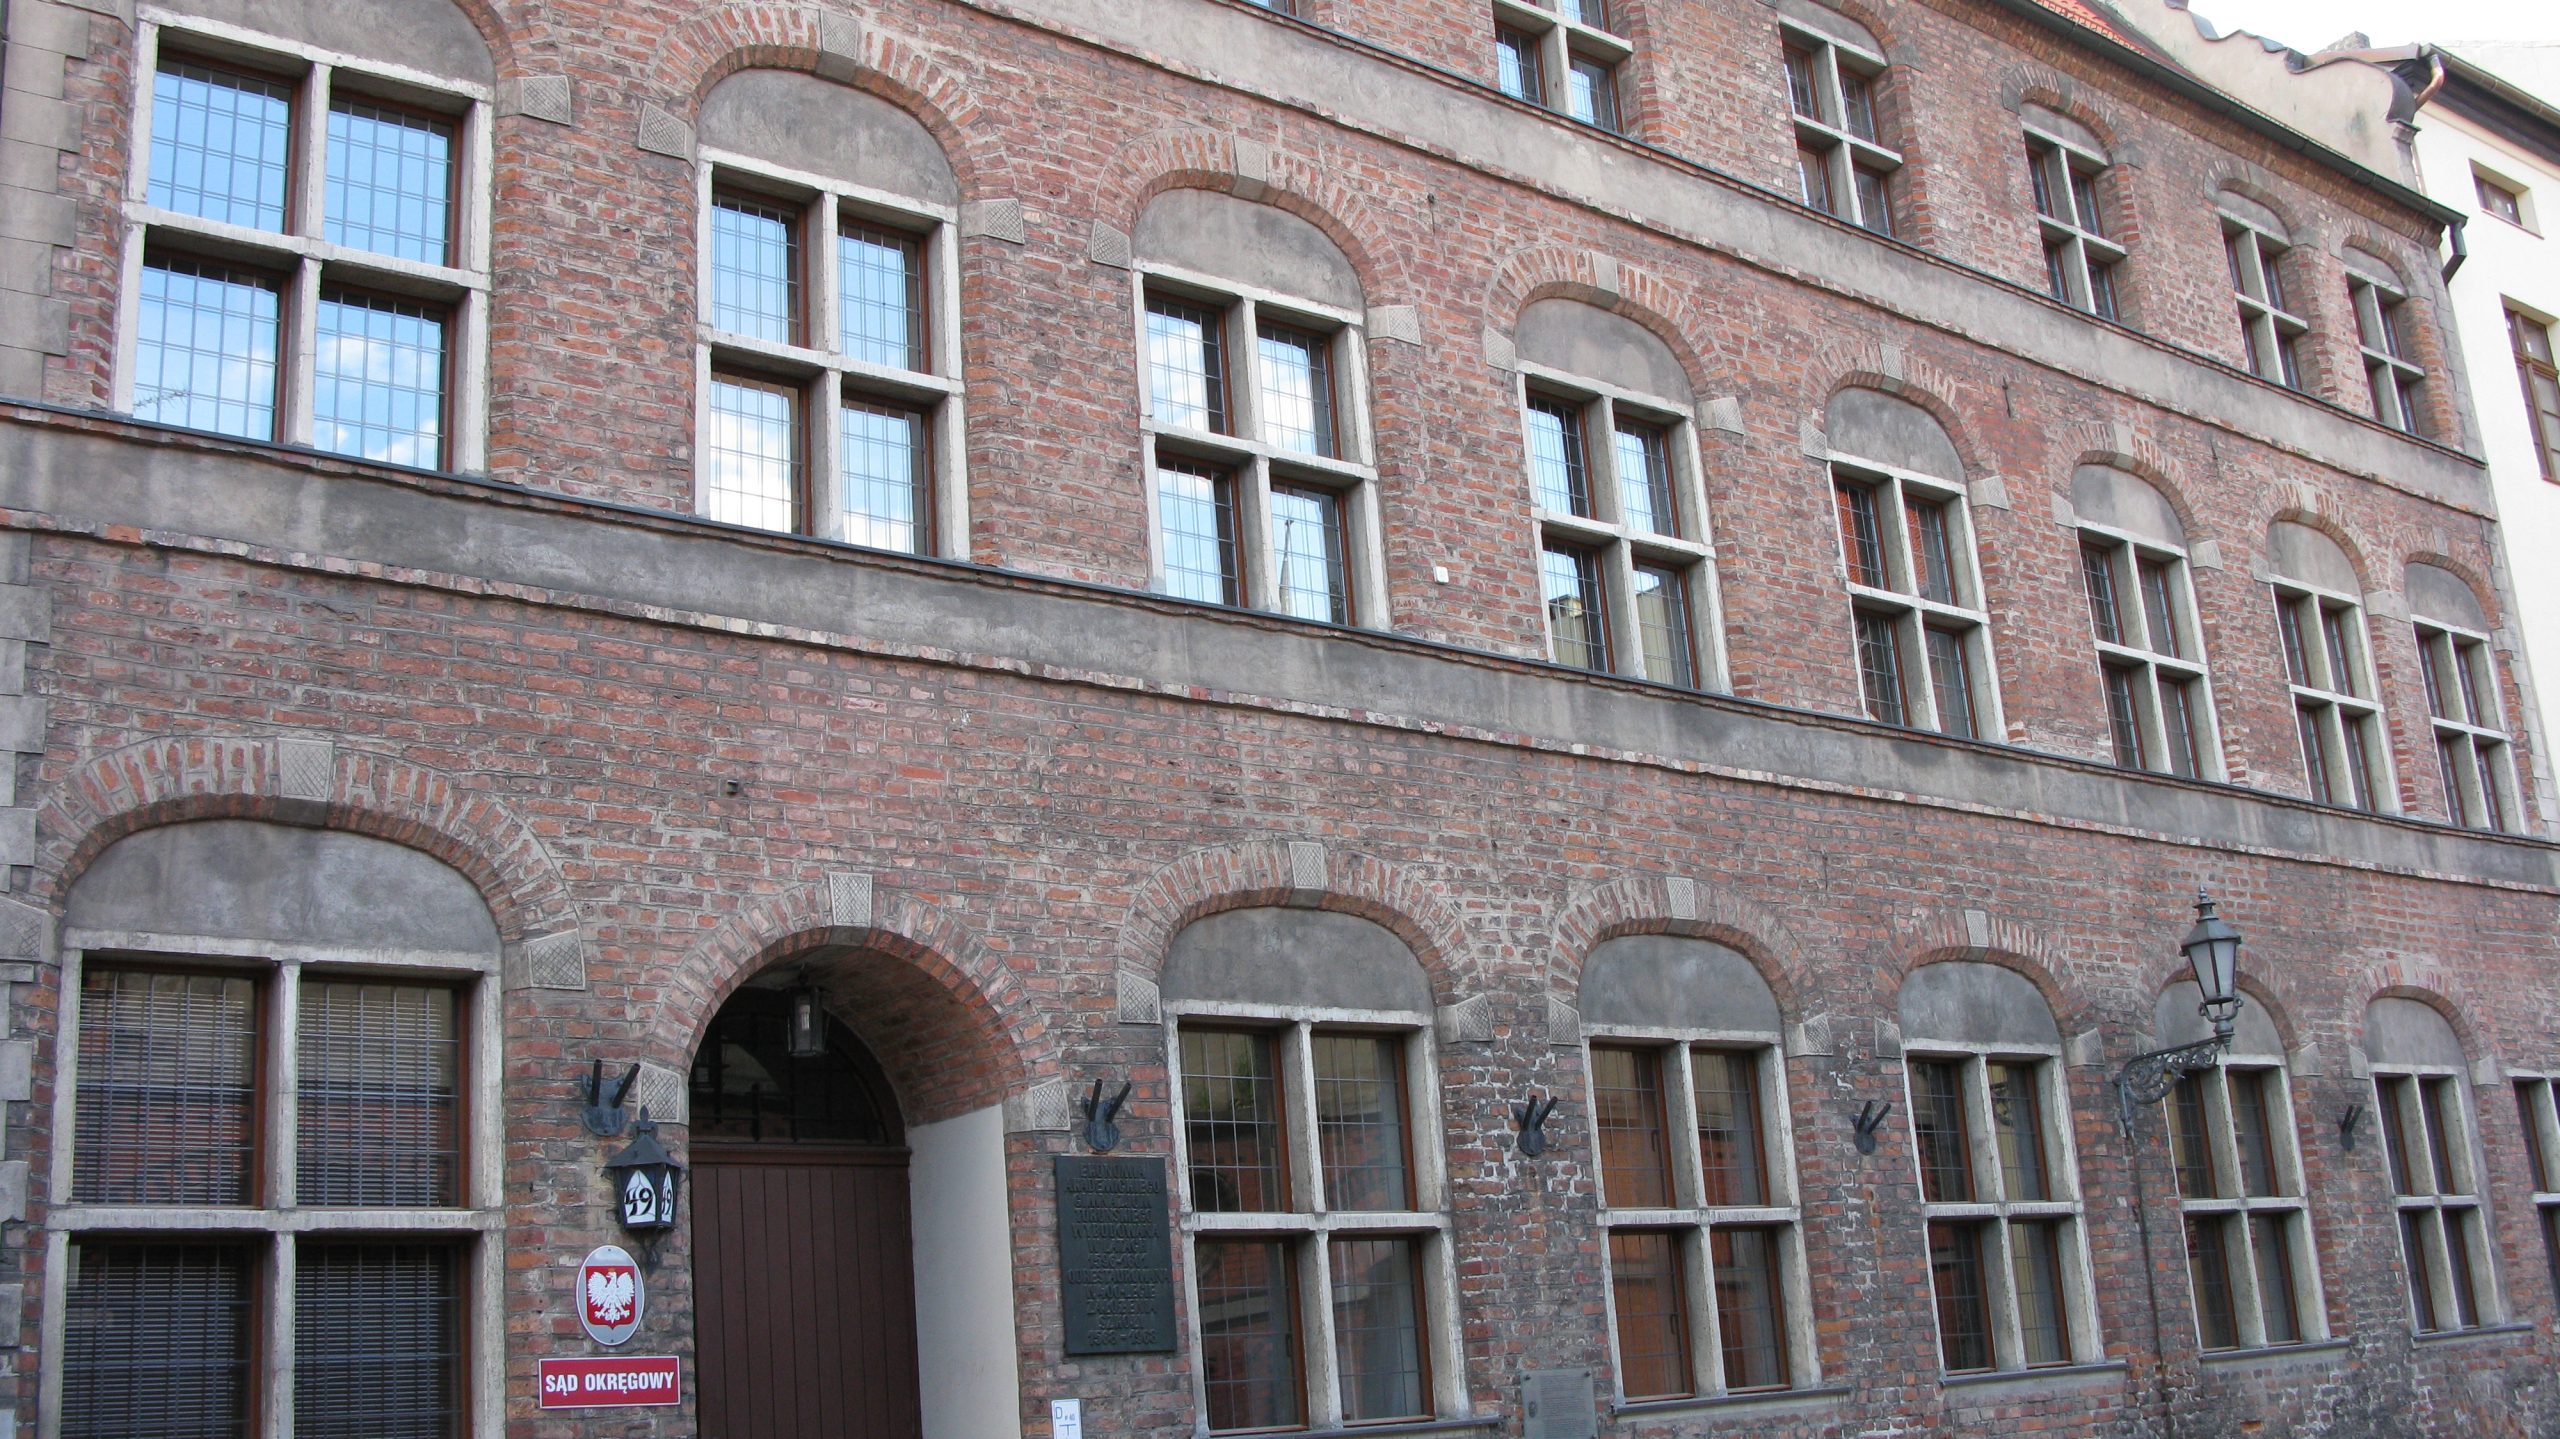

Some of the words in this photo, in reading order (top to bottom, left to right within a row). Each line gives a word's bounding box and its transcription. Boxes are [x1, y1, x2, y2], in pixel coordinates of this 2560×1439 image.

[1080, 1162, 1146, 1178] EKONOMIA
[1065, 1178, 1160, 1193] AKADEMICKIEGO
[624, 1187, 653, 1217] 49
[1071, 1223, 1160, 1239] WYBUDOWANA
[1068, 1269, 1171, 1284] ODRESTAUROWANA
[545, 1374, 578, 1396] SĄD
[584, 1372, 674, 1394] OKRĘGOWY
[1055, 1406, 1063, 1420] D
